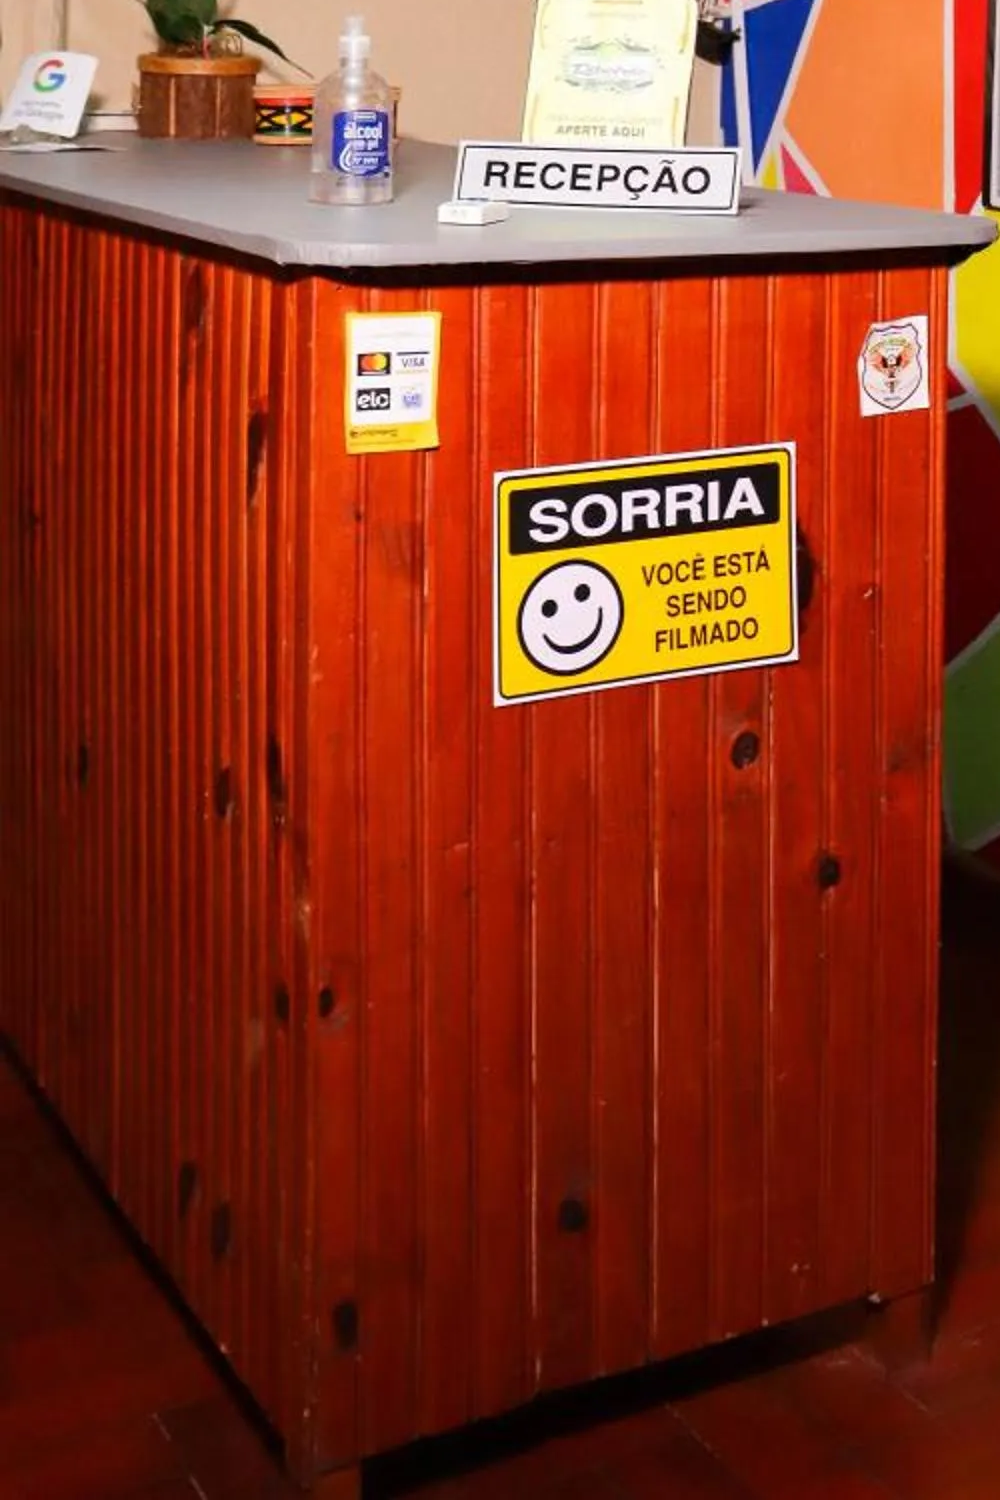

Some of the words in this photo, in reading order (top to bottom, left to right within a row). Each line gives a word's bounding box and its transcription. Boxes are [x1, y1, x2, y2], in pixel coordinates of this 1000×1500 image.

[33, 59, 66, 93] G
[483, 159, 711, 200] RECEPÇÃO
[528, 477, 765, 544] SORRIA
[642, 553, 706, 588] VOCÊ
[713, 544, 771, 578] ESTÁ
[666, 585, 747, 617] SENDO
[655, 617, 760, 654] FILMADO
